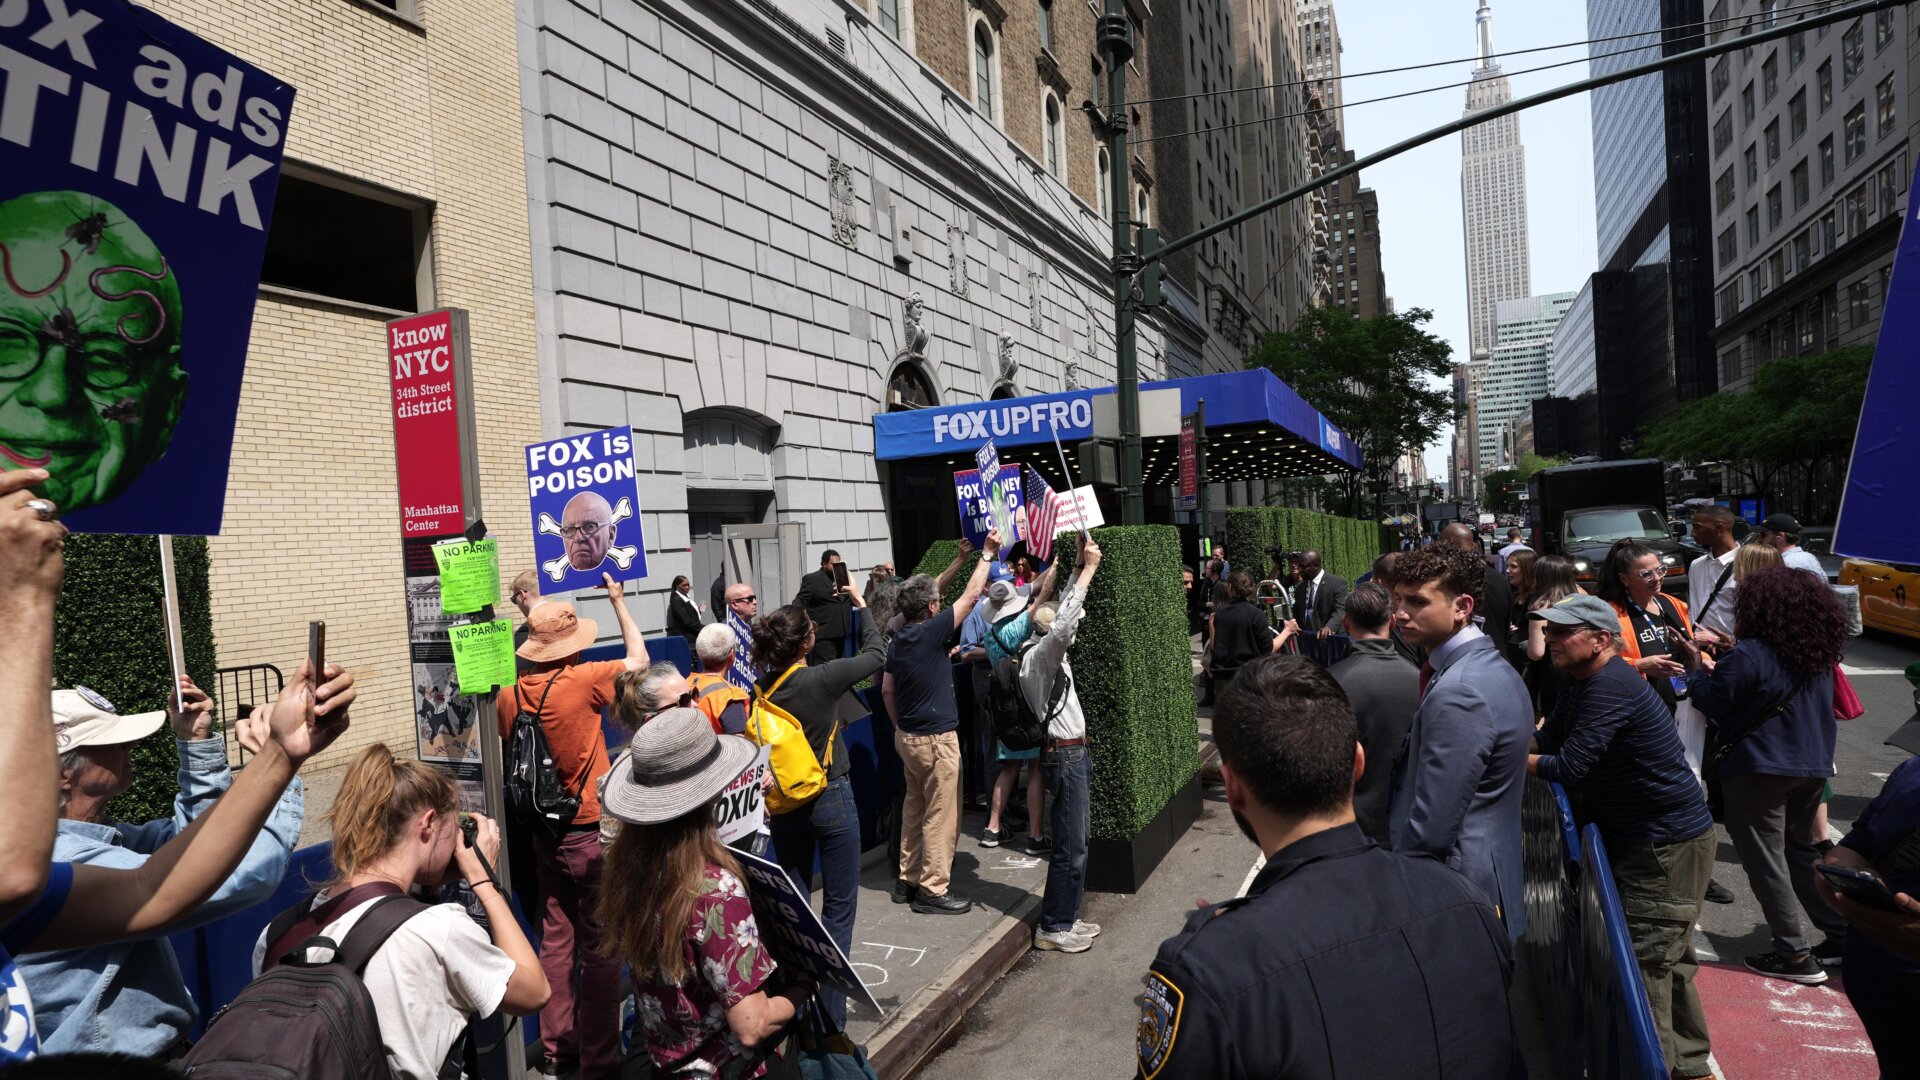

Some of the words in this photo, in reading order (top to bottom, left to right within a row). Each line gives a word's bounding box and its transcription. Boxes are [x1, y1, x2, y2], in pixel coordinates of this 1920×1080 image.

[133, 44, 282, 148] ads
[0, 44, 275, 231] TINK
[392, 324, 447, 349] know
[394, 345, 449, 380] NYC
[396, 386, 418, 400] 34th
[420, 380, 451, 396] Street
[398, 396, 452, 419] district
[990, 398, 1091, 437] UPFRO
[529, 436, 594, 471] FOX
[602, 432, 630, 457] is
[979, 448, 990, 468] FOX
[988, 441, 996, 457] IS
[529, 457, 634, 498] POISON
[982, 457, 1000, 488] POISON
[957, 483, 980, 500] FOX
[404, 504, 459, 518] Manhattan
[966, 501, 977, 517] is
[405, 520, 439, 532] Center
[443, 546, 460, 558] NO
[463, 542, 495, 555] PARKING
[456, 629, 469, 640] NO
[471, 623, 507, 637] PARKING
[755, 763, 765, 780] IS
[712, 782, 761, 830] OXIC
[747, 865, 794, 896] ers
